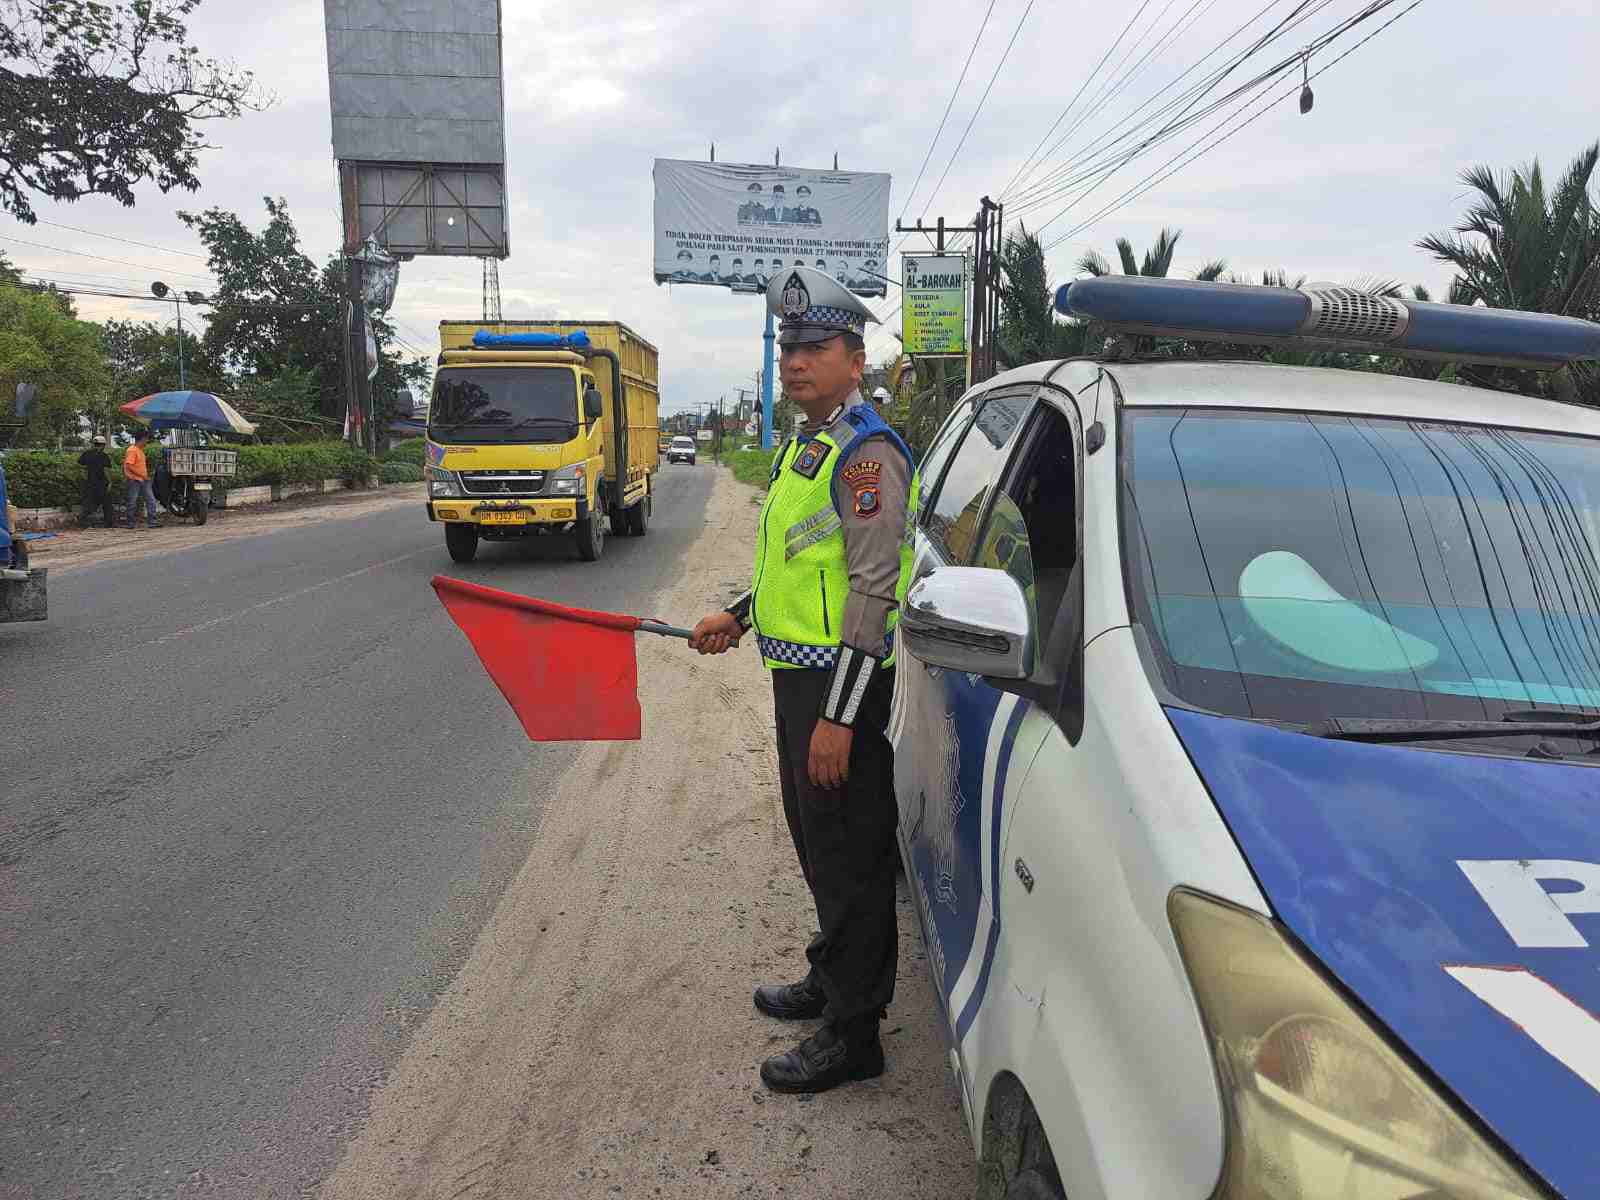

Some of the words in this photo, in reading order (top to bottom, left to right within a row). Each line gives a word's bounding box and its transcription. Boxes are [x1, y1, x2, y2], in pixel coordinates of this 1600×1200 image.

[665, 231, 687, 240] TIDAK
[688, 232, 712, 241] BOLEH
[906, 274, 961, 288] AL-BAROKAH
